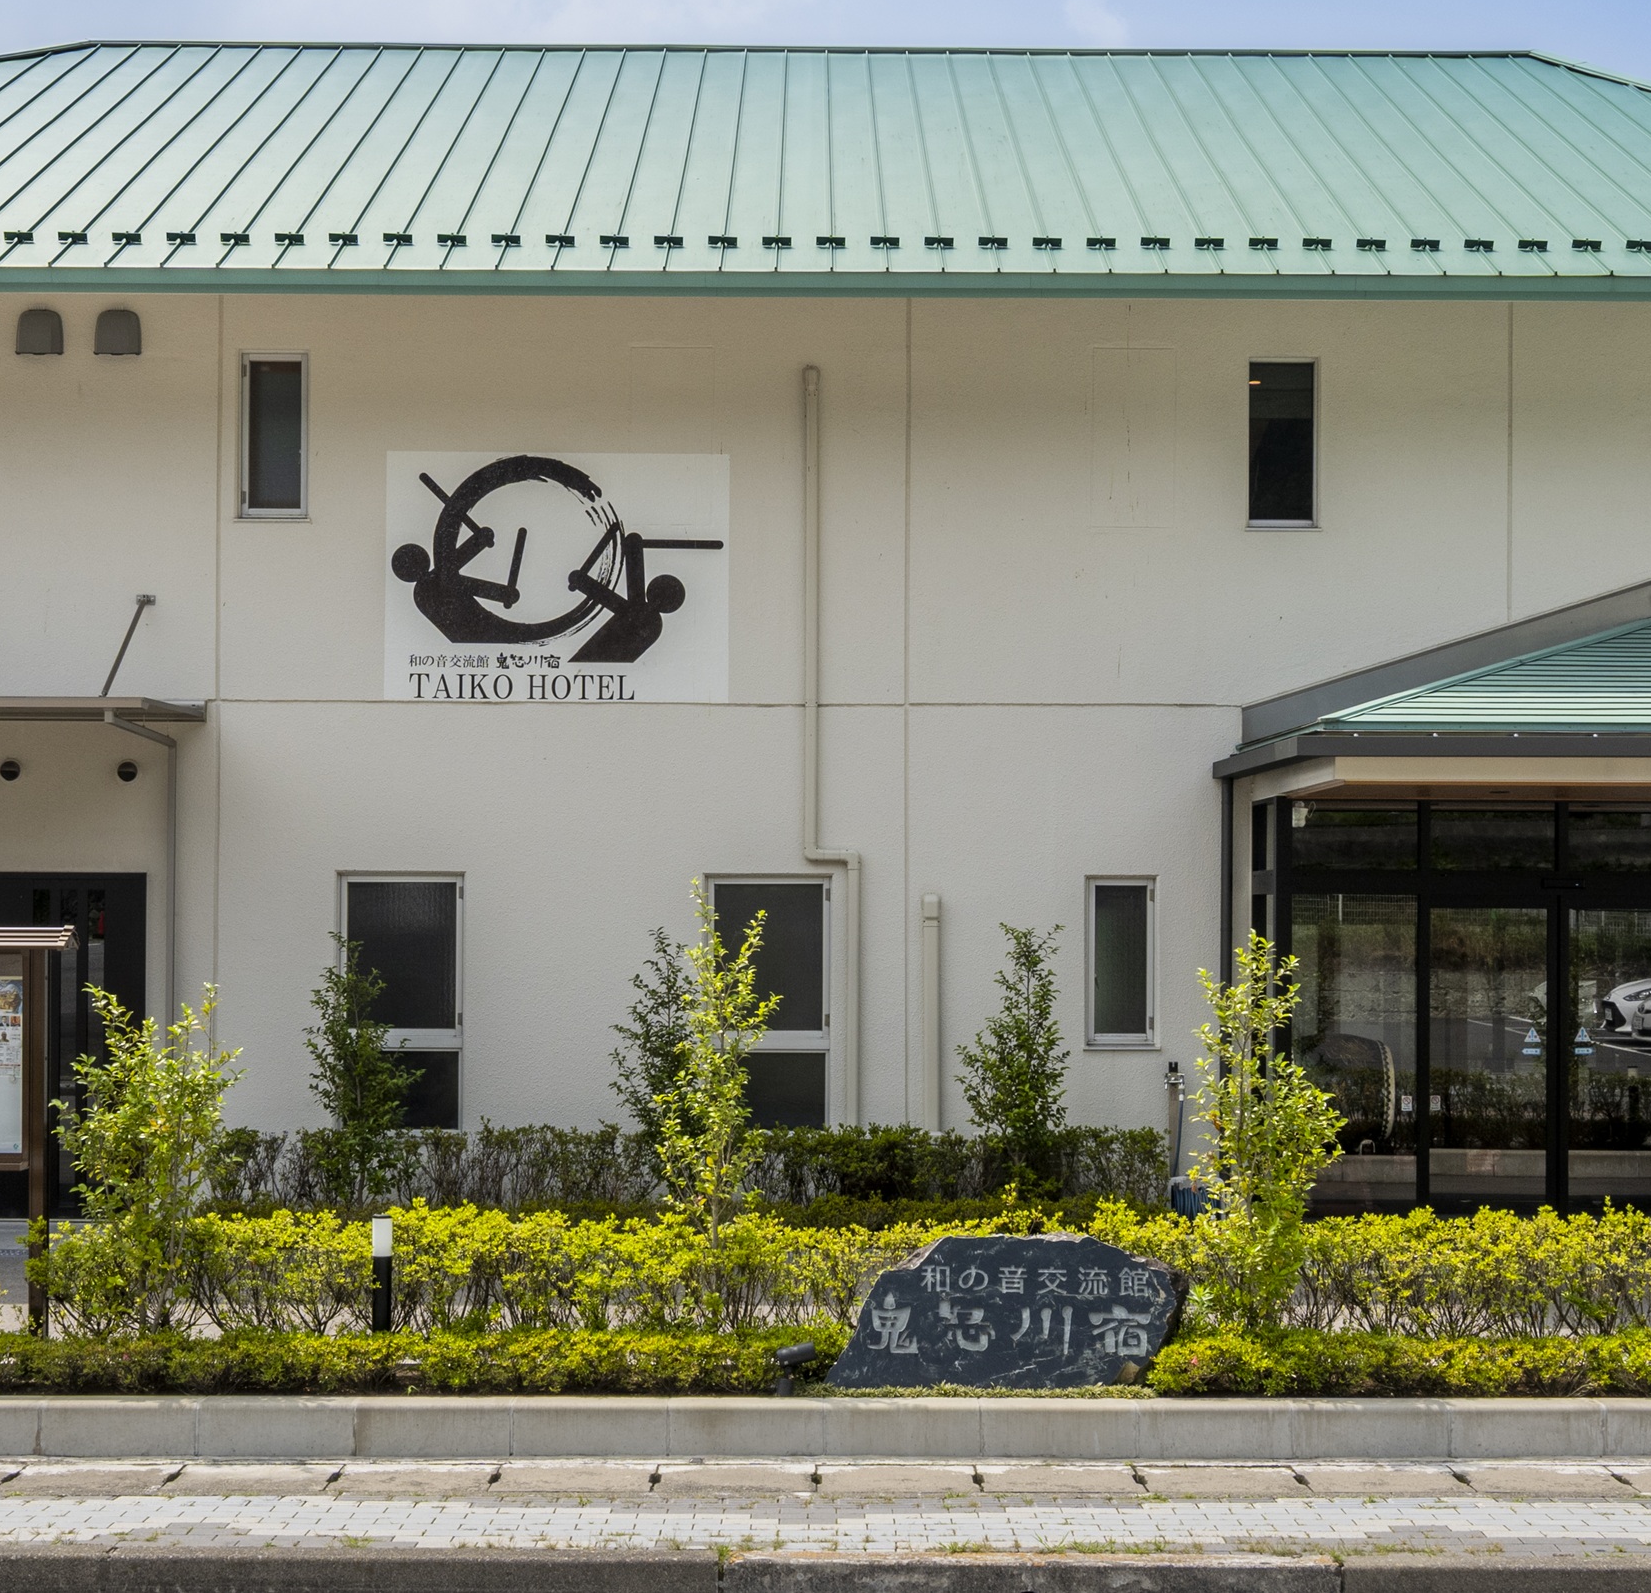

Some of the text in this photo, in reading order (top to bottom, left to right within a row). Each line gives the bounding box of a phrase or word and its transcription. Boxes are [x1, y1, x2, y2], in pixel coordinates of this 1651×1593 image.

[408, 651, 561, 670] 和の音交流館 鬼怒川宿
[408, 673, 636, 701] TAIKO HOTEL
[921, 1264, 1150, 1297] 和の音交流館
[866, 1291, 1151, 1358] 鬼怒川宿
